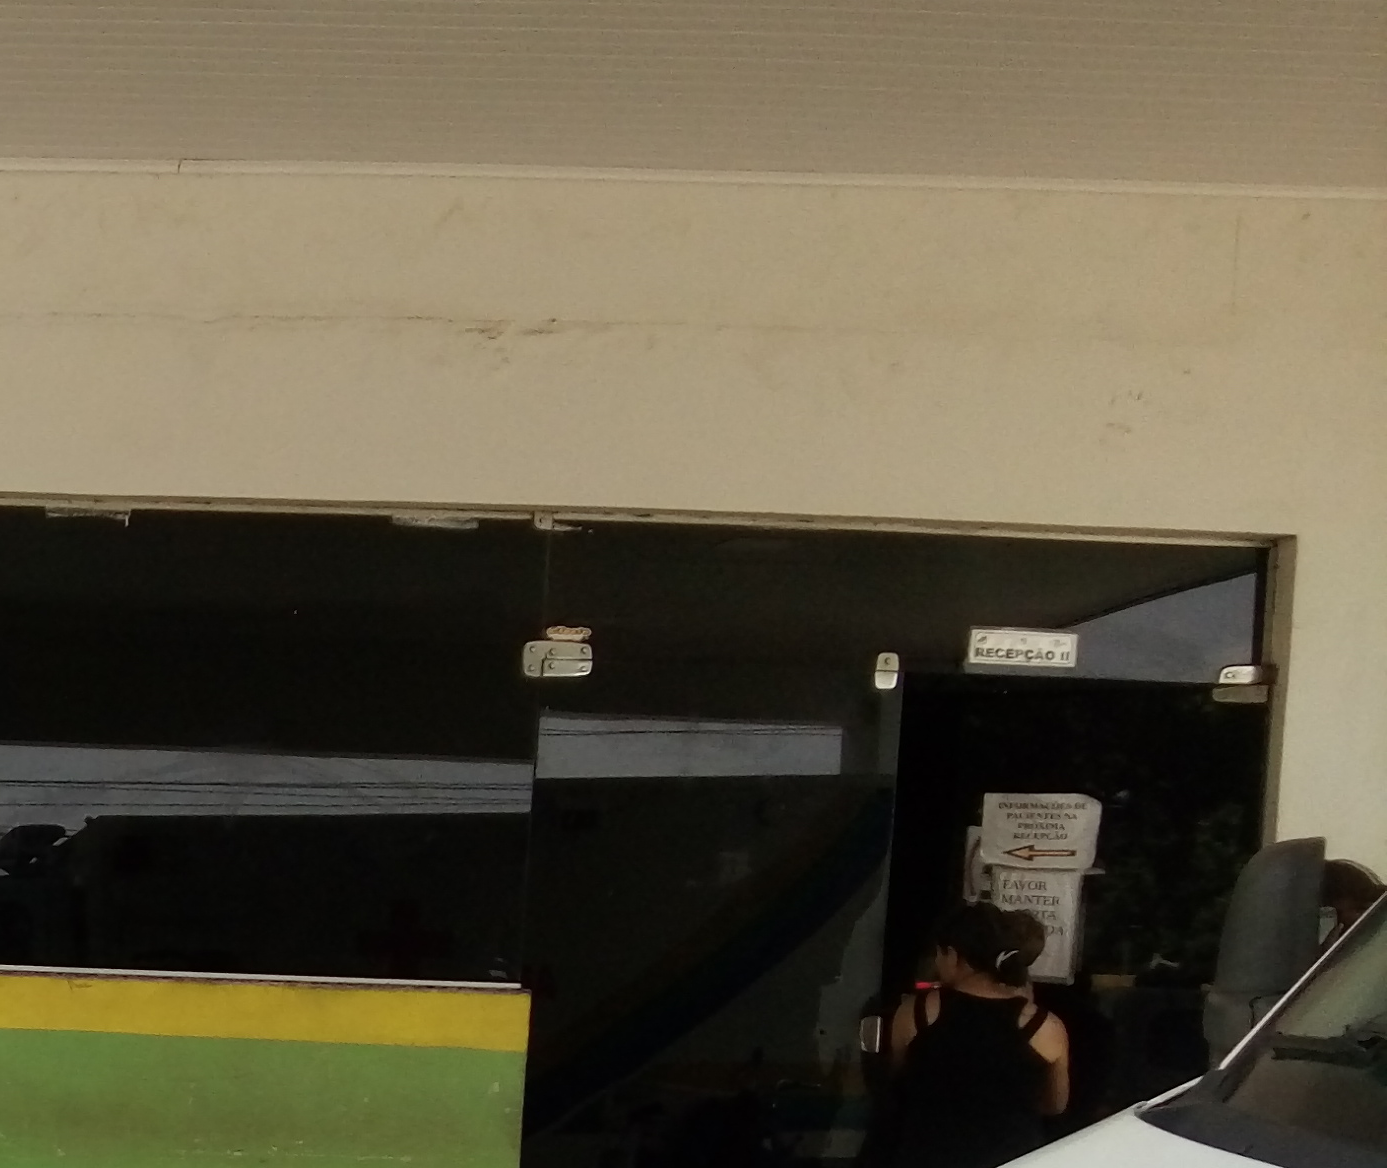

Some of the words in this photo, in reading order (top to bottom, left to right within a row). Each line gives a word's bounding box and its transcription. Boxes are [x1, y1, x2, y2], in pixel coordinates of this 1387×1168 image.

[974, 647, 1055, 662] RECEPÇÃO
[1002, 879, 1047, 891] FAVOR
[1001, 894, 1061, 906] MANTER
